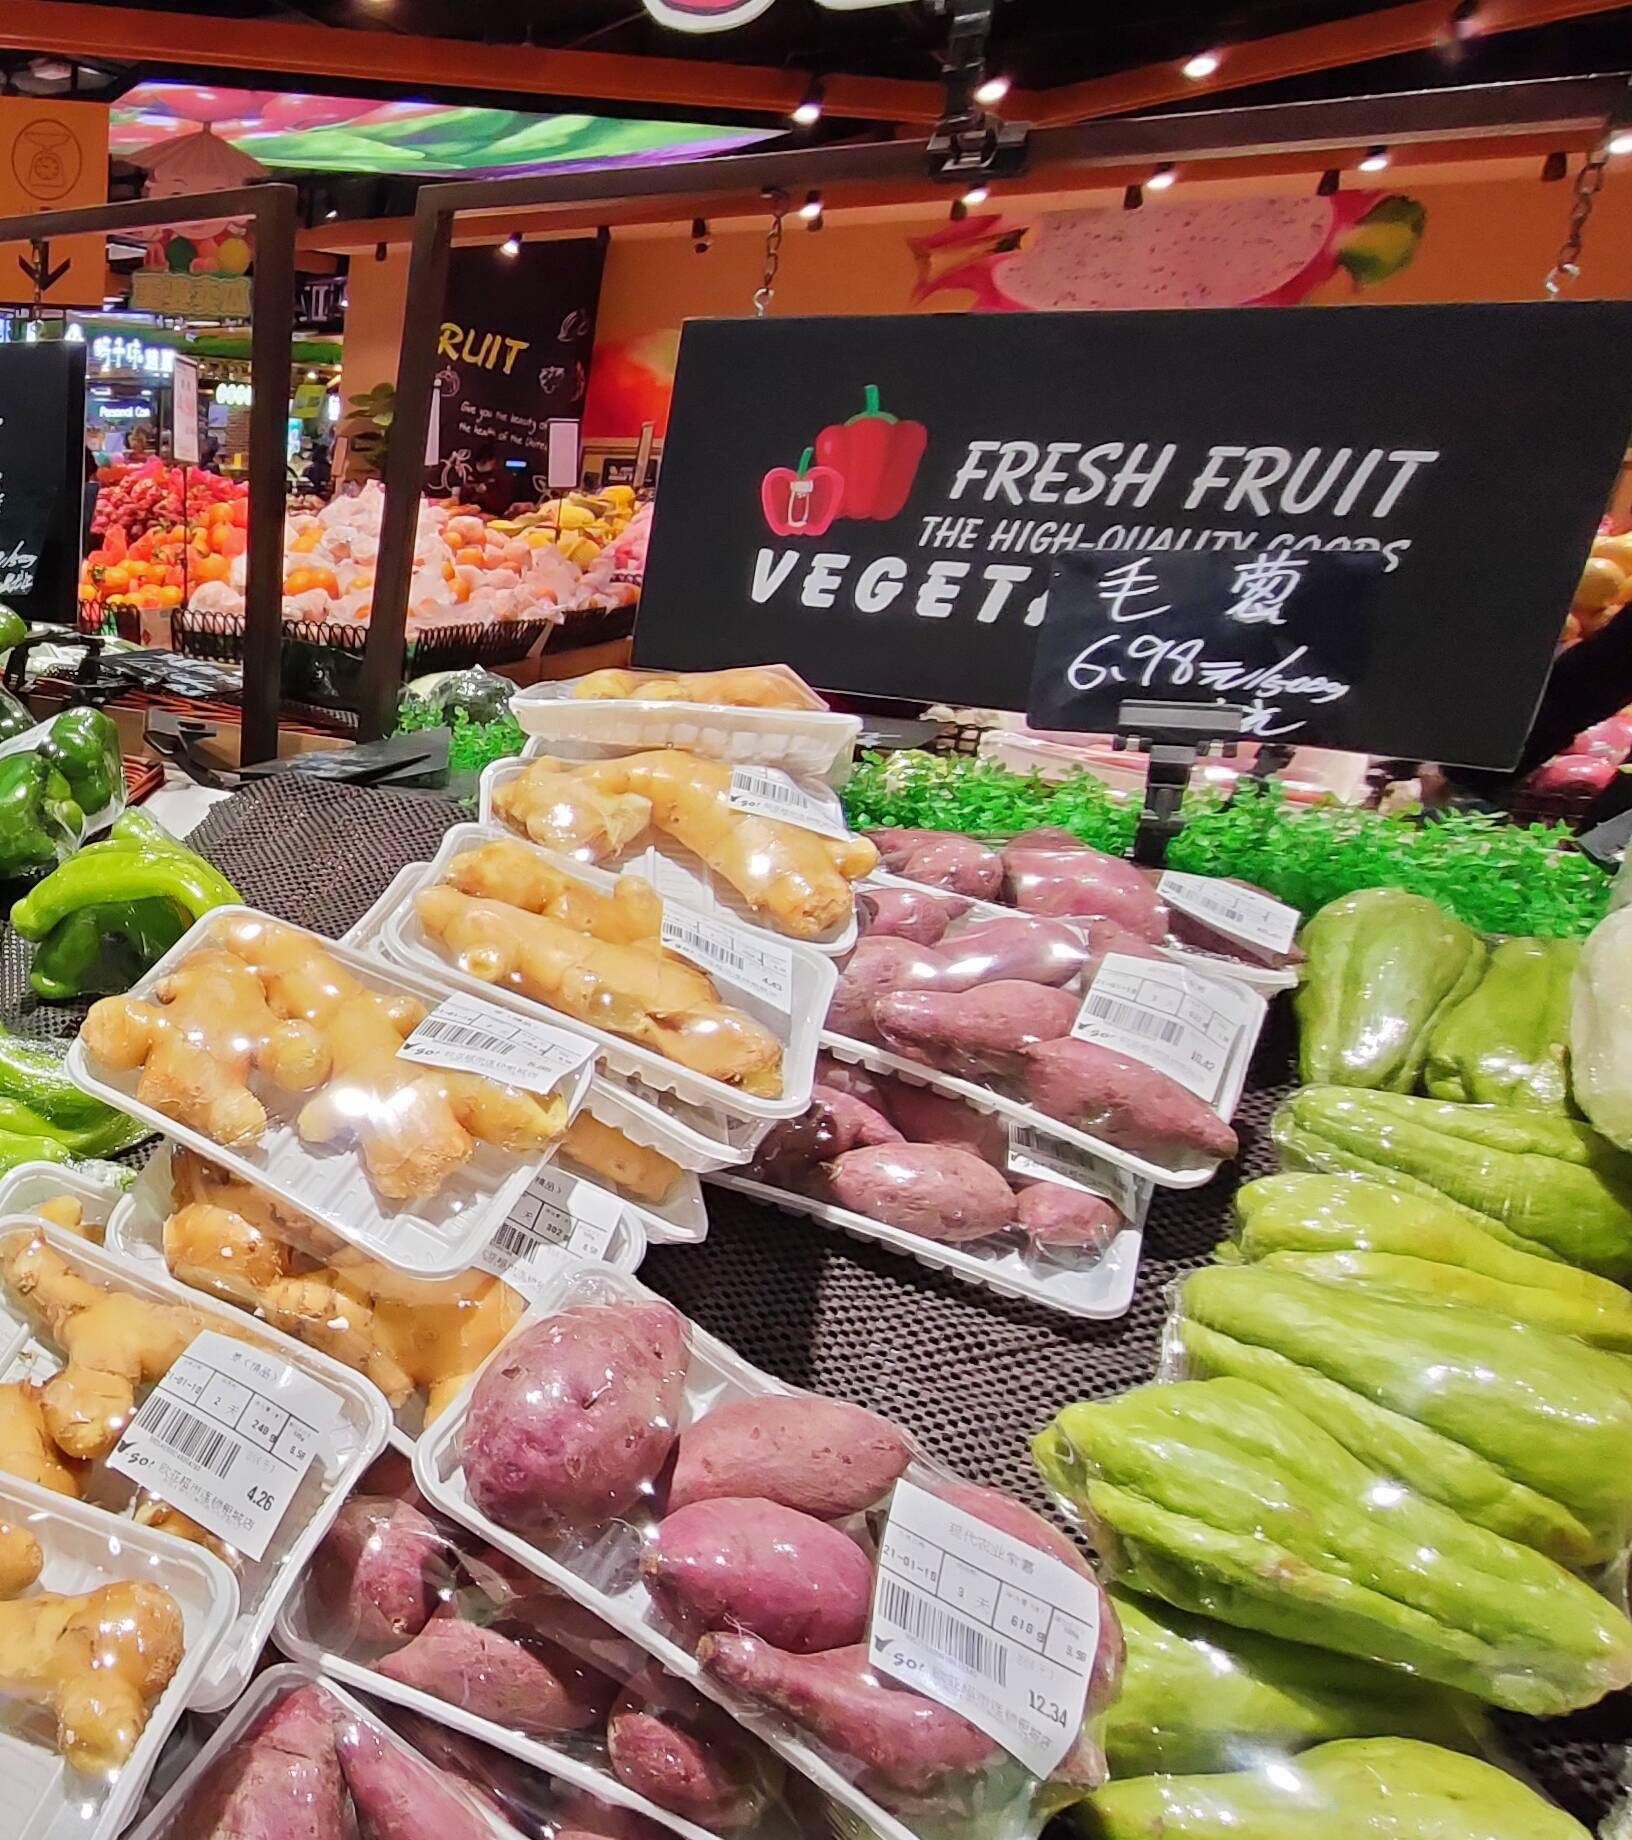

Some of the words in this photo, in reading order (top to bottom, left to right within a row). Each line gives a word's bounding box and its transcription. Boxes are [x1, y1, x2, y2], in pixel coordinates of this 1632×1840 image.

[438, 322, 530, 375] RUIT
[948, 440, 1177, 507] FRESH
[1183, 445, 1440, 518] FRUIT
[918, 515, 984, 548] THE
[246, 1485, 275, 1512] 4.26
[1028, 1689, 1068, 1729] 12.34
